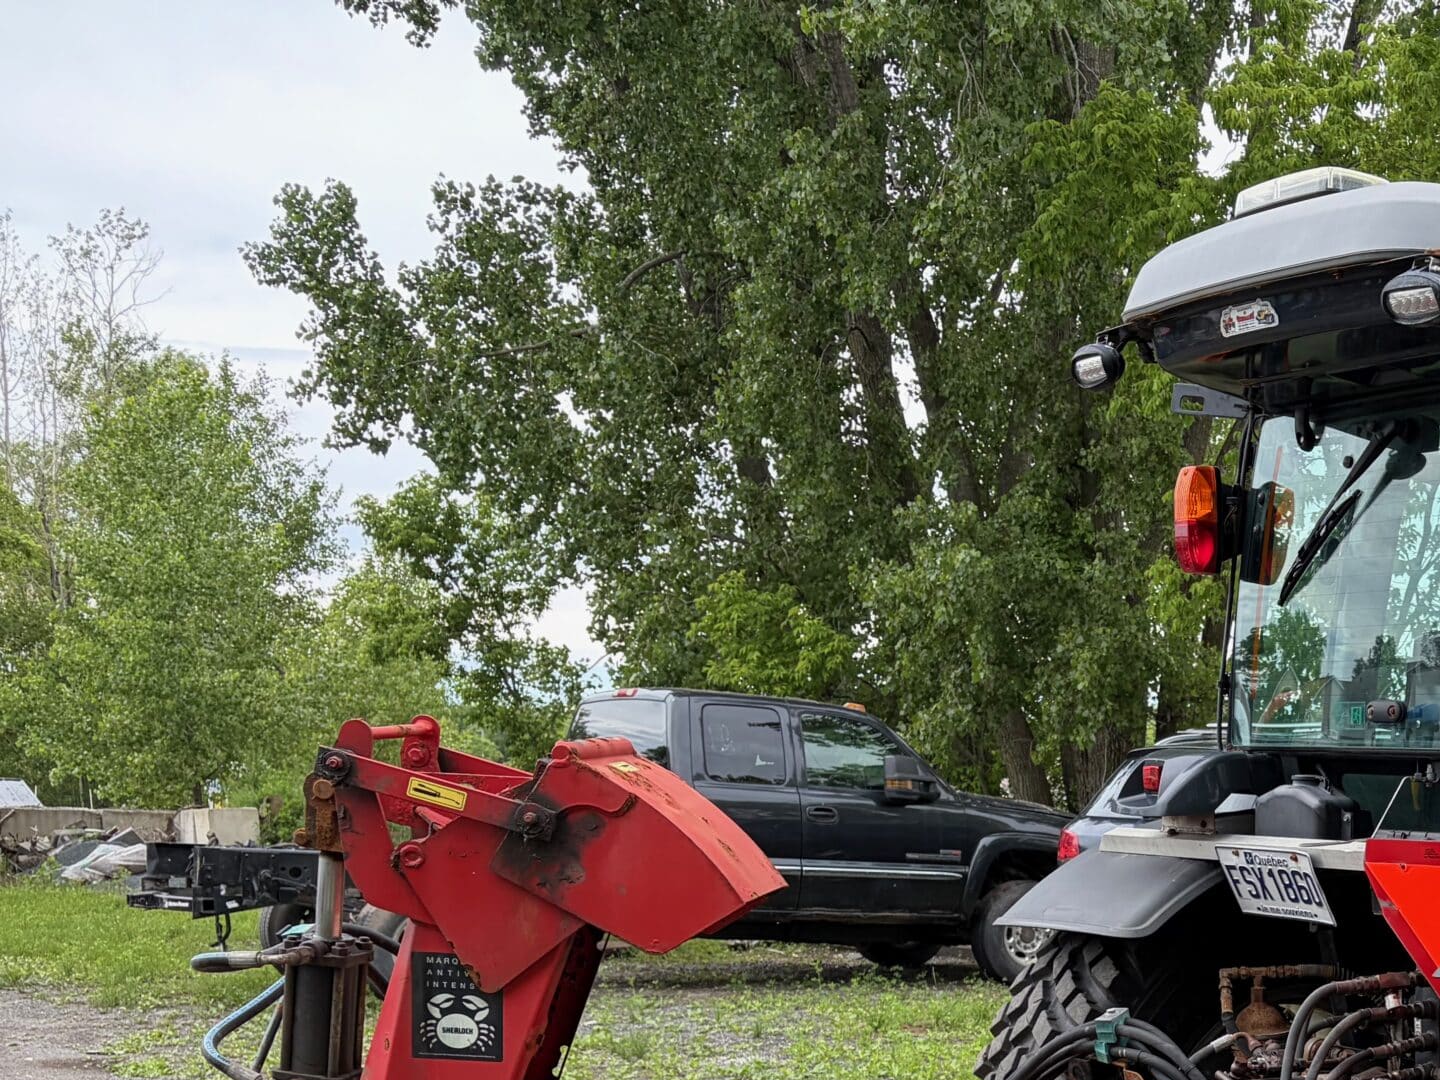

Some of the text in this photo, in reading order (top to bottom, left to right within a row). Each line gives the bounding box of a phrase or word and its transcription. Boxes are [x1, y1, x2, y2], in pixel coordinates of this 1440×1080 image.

[1224, 864, 1324, 908] FSX1860
[426, 956, 459, 965] MARQ
[426, 968, 470, 977] ANTIV
[426, 980, 476, 990] INTENS
[442, 1026, 474, 1035] SHERLOCK
